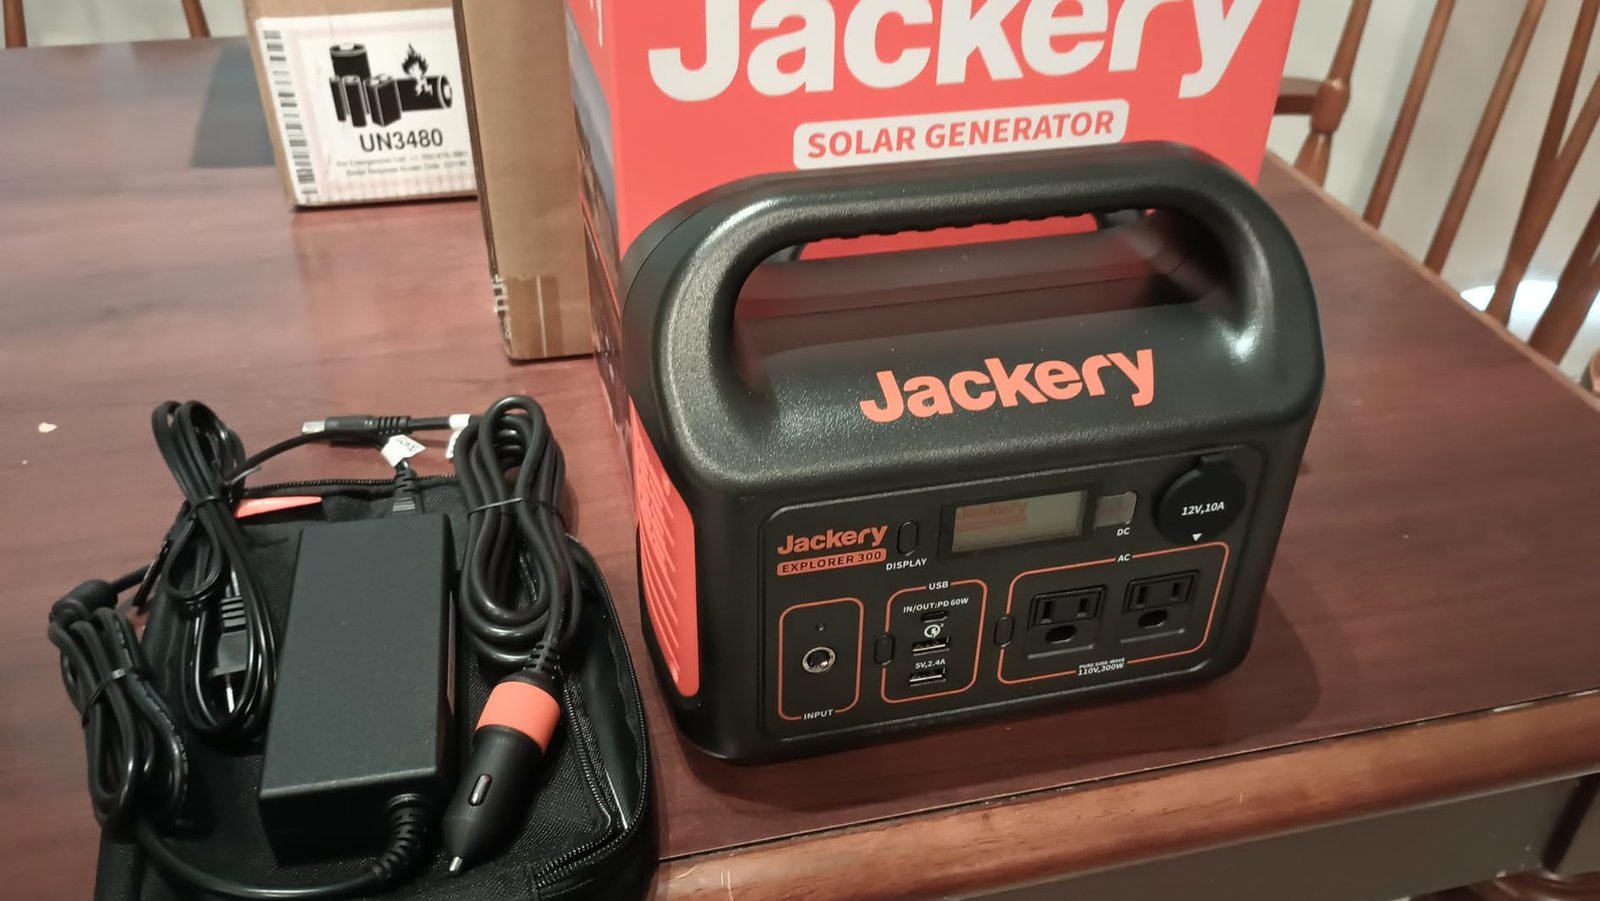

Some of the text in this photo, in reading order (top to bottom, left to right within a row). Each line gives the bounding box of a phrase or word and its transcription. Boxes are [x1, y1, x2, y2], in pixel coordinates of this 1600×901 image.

[648, 0, 1262, 102] Jackery
[359, 127, 444, 153] UN3480
[807, 109, 1115, 159] SOLAR GENERATOR
[859, 348, 1155, 423] Jackery
[1181, 501, 1225, 517] 12V,10A
[1116, 527, 1131, 537] DC
[777, 525, 889, 556] Jackery
[782, 550, 882, 574] EXPLORER 300
[885, 557, 928, 572] DISPLAY
[1117, 553, 1131, 563] AC
[928, 580, 949, 592] USB
[950, 597, 969, 607] 60W
[915, 658, 946, 670] 5V,2.4A
[1078, 662, 1125, 677] 110V,300W
[803, 709, 834, 720] INPUT
